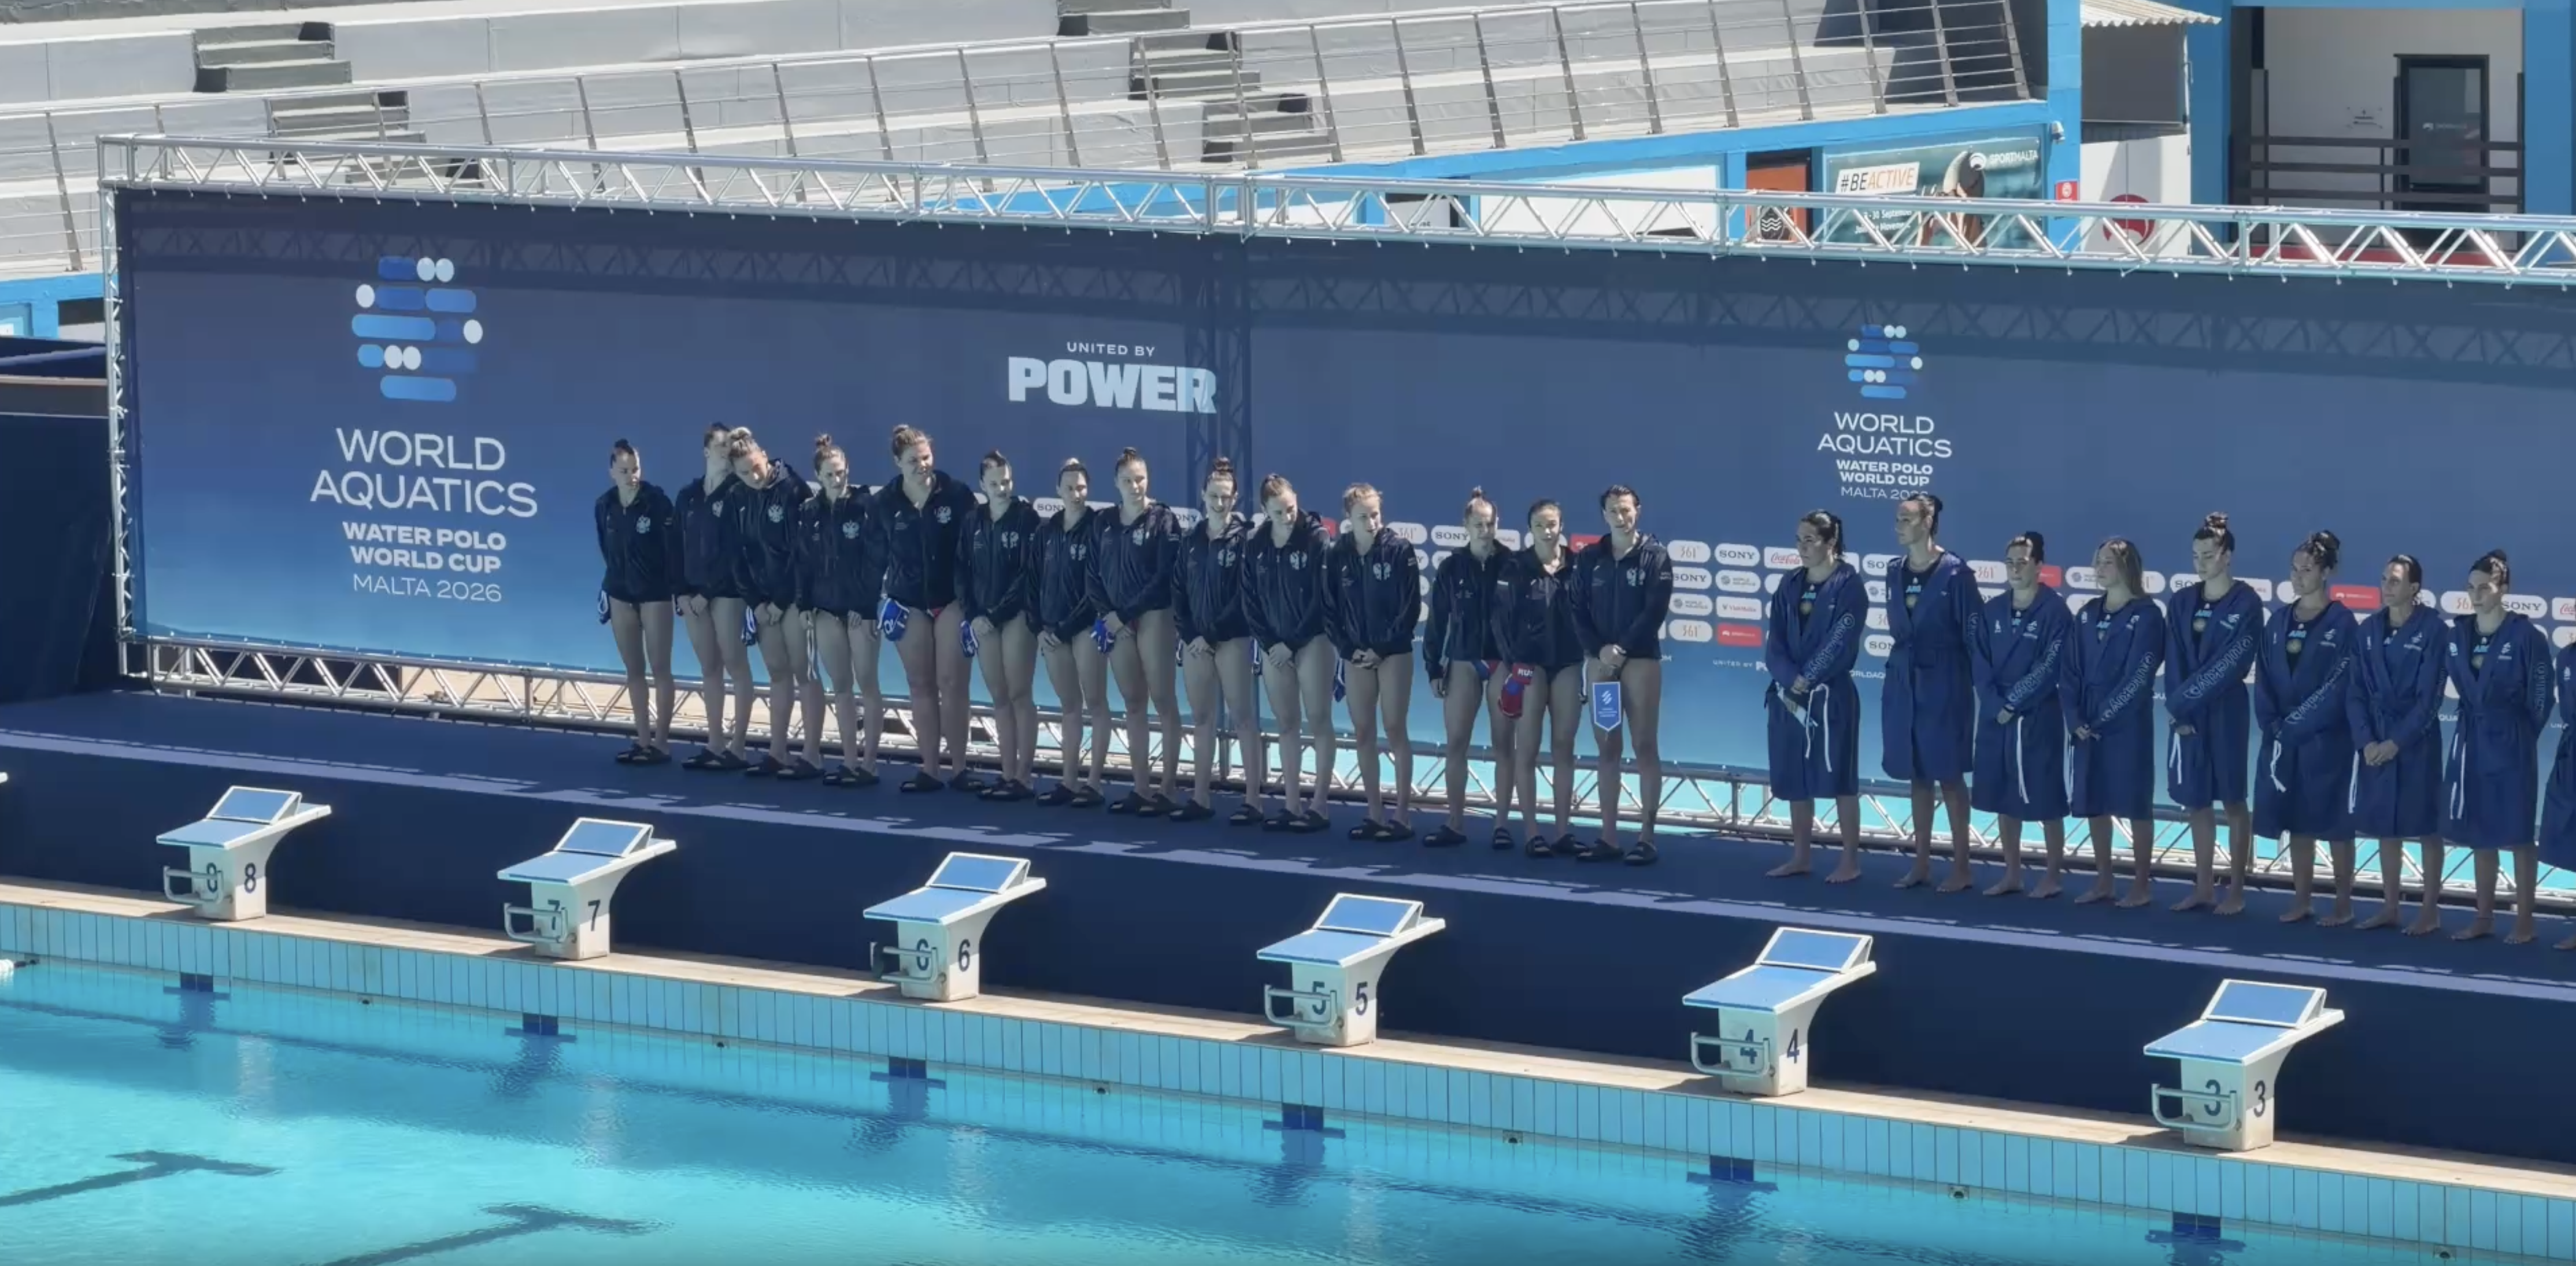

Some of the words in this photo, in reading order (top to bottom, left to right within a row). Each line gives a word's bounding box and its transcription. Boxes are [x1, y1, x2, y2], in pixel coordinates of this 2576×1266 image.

[1841, 168, 1915, 193] #BEACTIVE
[1067, 342, 1128, 355] UNITED
[1135, 346, 1155, 357] BY
[1008, 356, 1217, 414] POWER
[1834, 411, 1935, 435] WORLD
[336, 427, 506, 471] WORLD
[1817, 433, 1952, 458] AQUATICS
[1836, 459, 1889, 473] WATER
[1892, 462, 1934, 475] POLO
[1840, 471, 1896, 485] WORLD
[1897, 475, 1930, 487] CUP
[310, 469, 538, 518] AQUATICS
[1841, 486, 1888, 499] MALTA
[343, 521, 431, 546] WATER
[436, 527, 506, 550] POLO
[350, 545, 444, 570] WORLD
[449, 551, 501, 574] CUP
[1719, 550, 1755, 560] SONY
[353, 573, 431, 598] MALTA
[436, 578, 501, 602] 2026
[2502, 601, 2542, 612] SONY
[243, 862, 257, 894] 8
[587, 899, 601, 932] 7
[958, 938, 971, 972] 6
[1355, 980, 1368, 1016] 5
[1787, 1028, 1800, 1064] 4
[2253, 1079, 2266, 1117] 3
